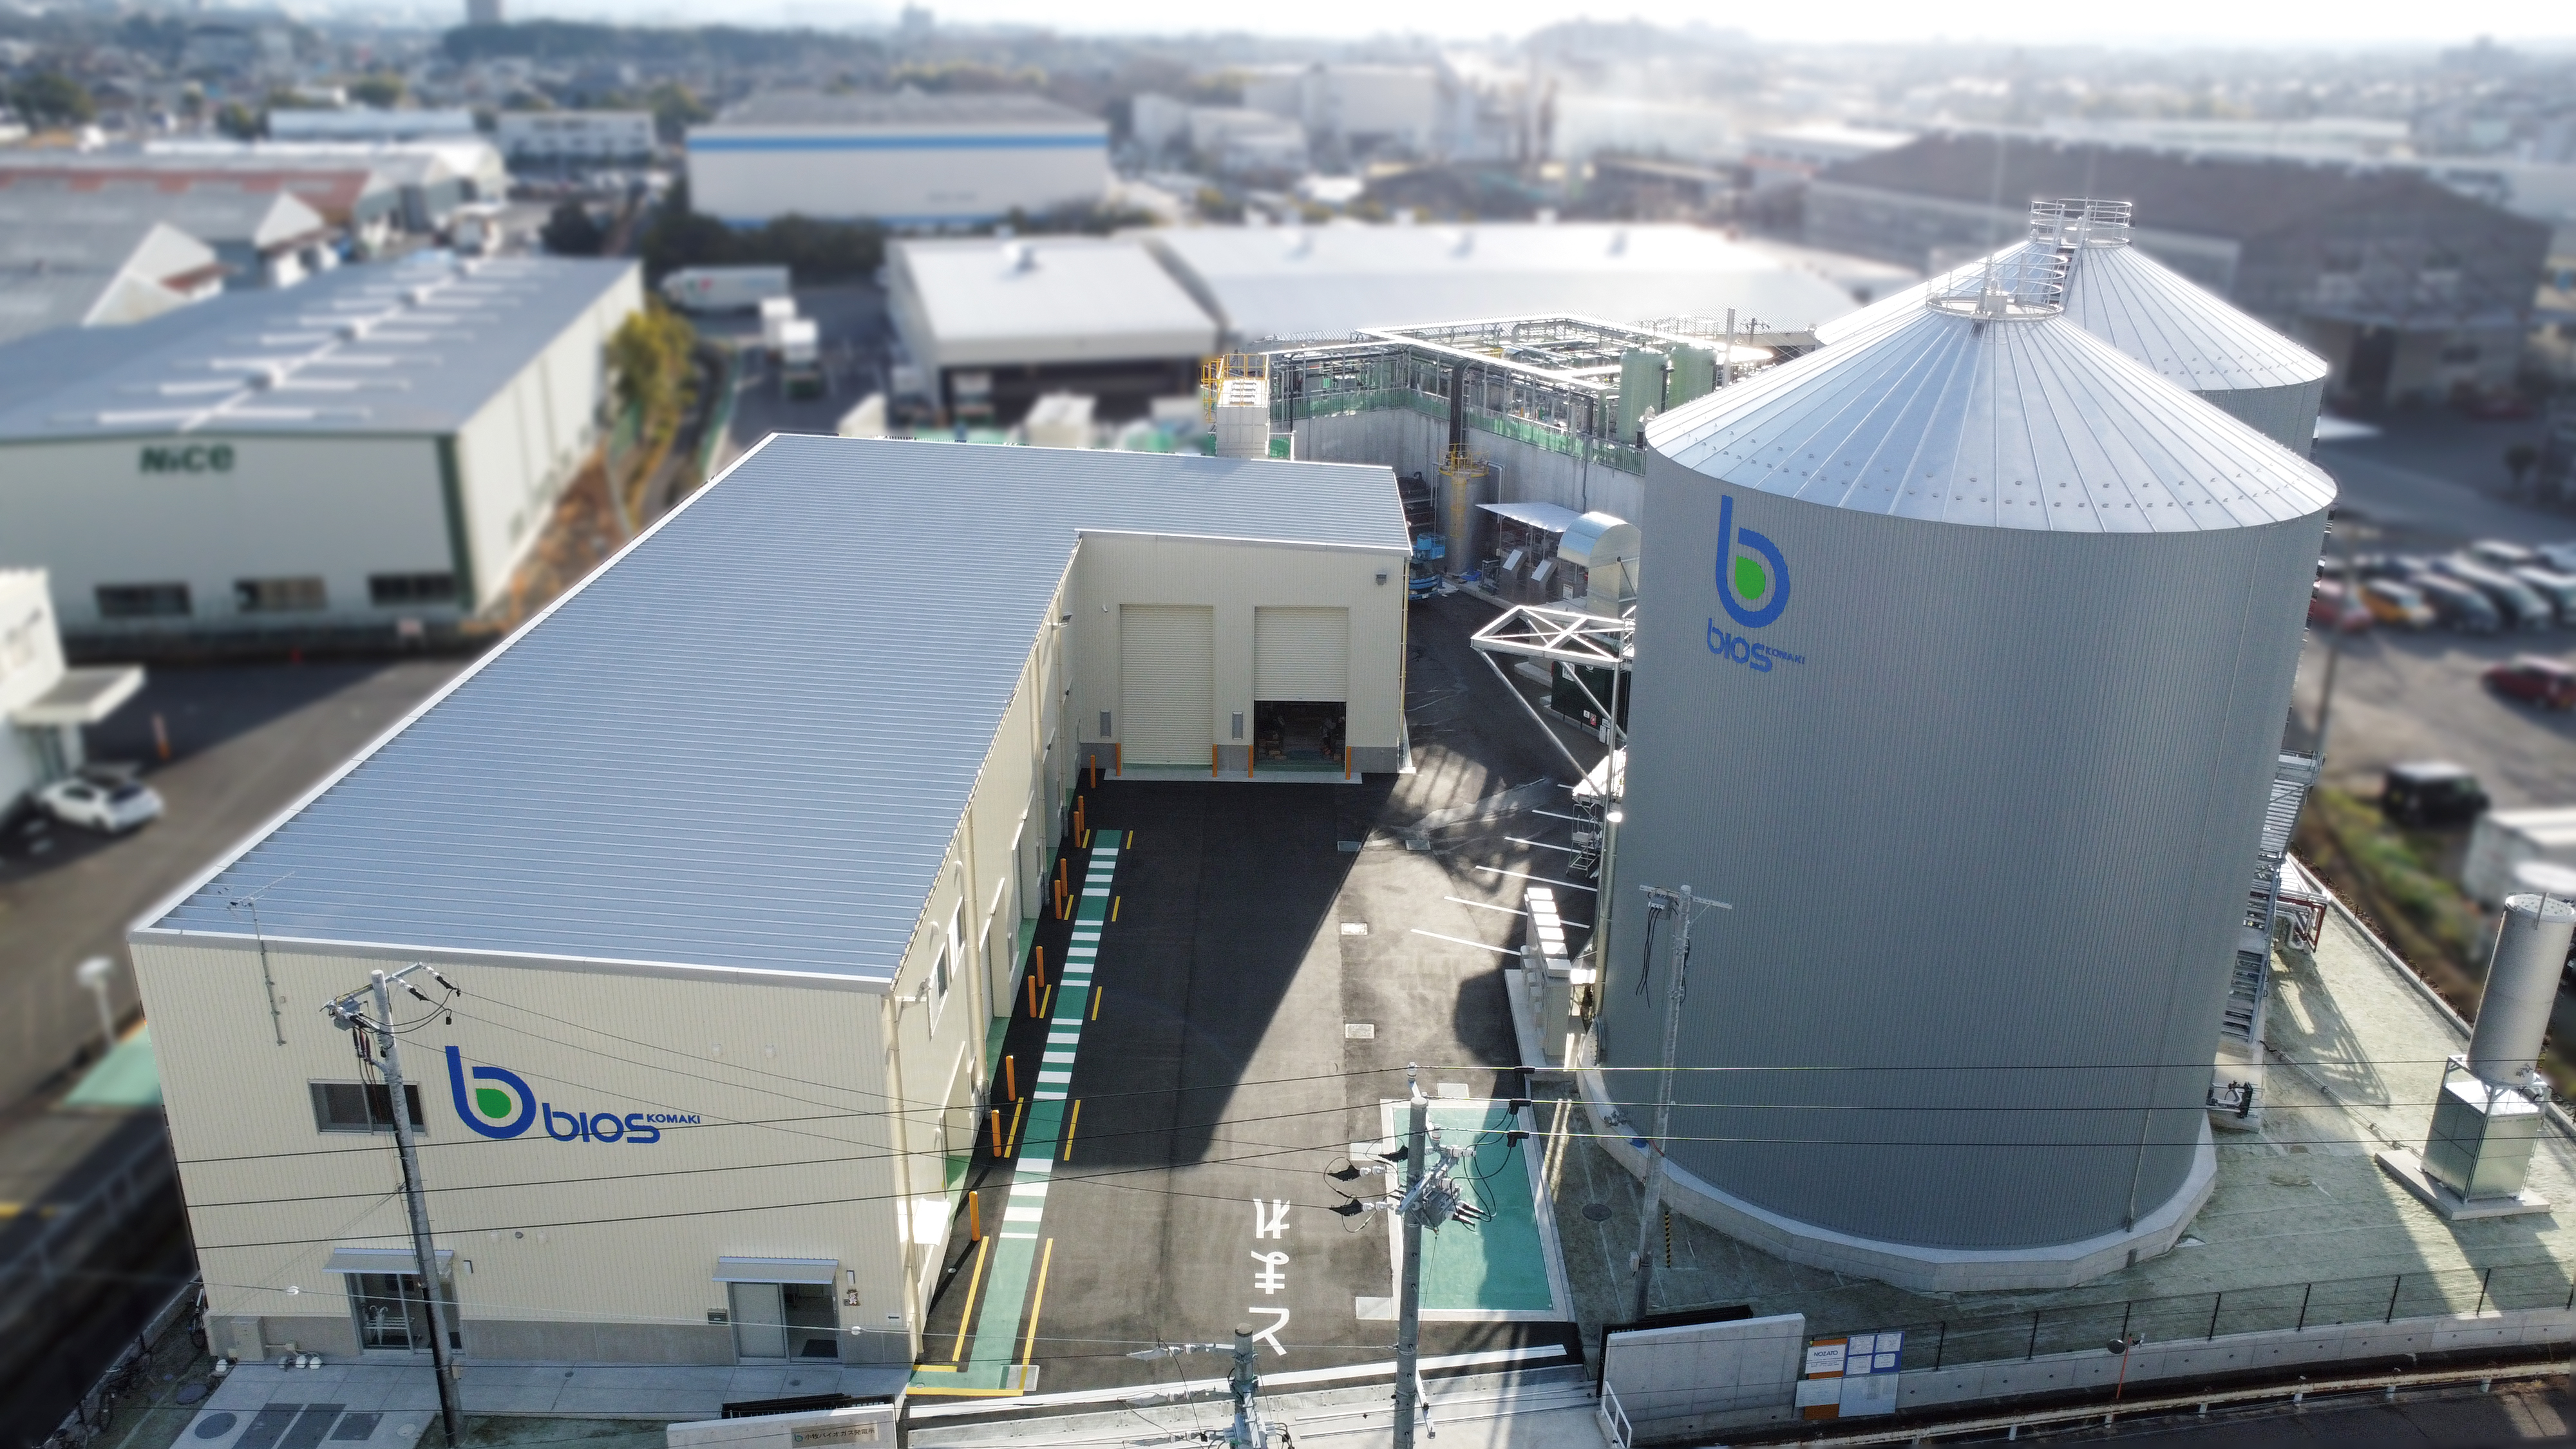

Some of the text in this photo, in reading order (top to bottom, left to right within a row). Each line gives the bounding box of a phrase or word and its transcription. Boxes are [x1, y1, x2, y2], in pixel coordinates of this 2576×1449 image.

[1765, 644, 1805, 665] KOMAKI
[646, 1113, 701, 1124] KOMAKI
[1249, 1198, 1290, 1356] とまれ
